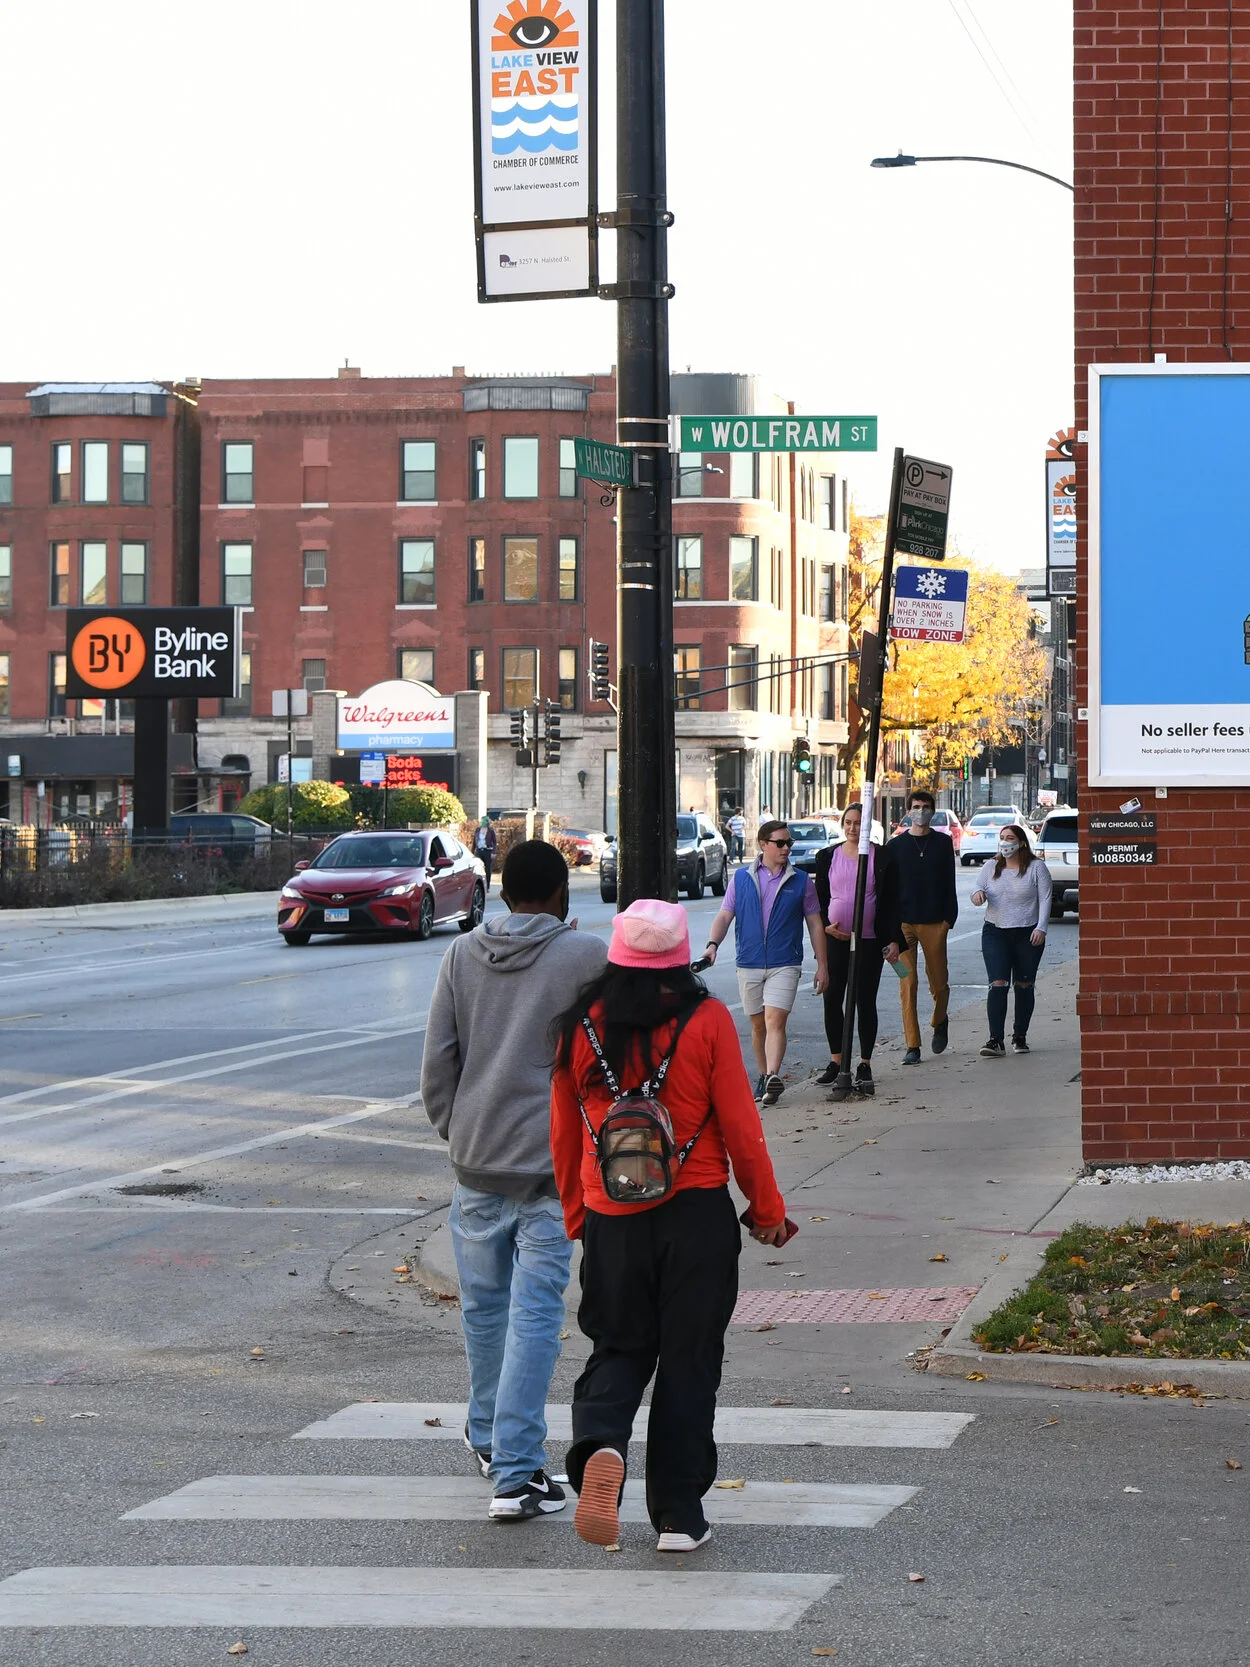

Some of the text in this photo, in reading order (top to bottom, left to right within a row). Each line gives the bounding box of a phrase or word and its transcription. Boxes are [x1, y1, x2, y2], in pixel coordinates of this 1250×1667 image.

[491, 51, 579, 69] LAKE VIEW
[491, 67, 579, 98] EAST
[493, 155, 579, 169] CHAMBER OF COMMERCE
[493, 180, 580, 192] www.lakevieweast.com
[691, 420, 868, 448] W WOLFRAM ST
[585, 445, 626, 480] HALSTED
[903, 489, 914, 498] PAY
[914, 492, 922, 500] AT
[922, 494, 934, 503] PAY
[934, 496, 947, 506] BOX
[1053, 504, 1076, 515] EA
[925, 546, 939, 559] 207
[897, 600, 943, 610] NO PARKING
[897, 608, 953, 619] WHEN SNOW IS
[896, 616, 954, 628] OVER 2 INCHES
[895, 627, 957, 641] TOW ZONE
[155, 627, 228, 656] Byline
[89, 634, 131, 673] BY
[155, 654, 216, 678] Bank
[343, 705, 450, 729] Walgreens
[1141, 724, 1163, 737] No
[1167, 722, 1208, 737] seller
[1213, 722, 1244, 736] fees
[368, 735, 423, 747] pharmacy
[1154, 747, 1182, 755] applicable
[1191, 747, 1210, 755] PayPal
[387, 756, 423, 768] Soda
[386, 769, 421, 780] acks
[1108, 821, 1140, 829] CHICAGO,
[1093, 853, 1153, 863] 100850342
[587, 1027, 603, 1056] adidas
